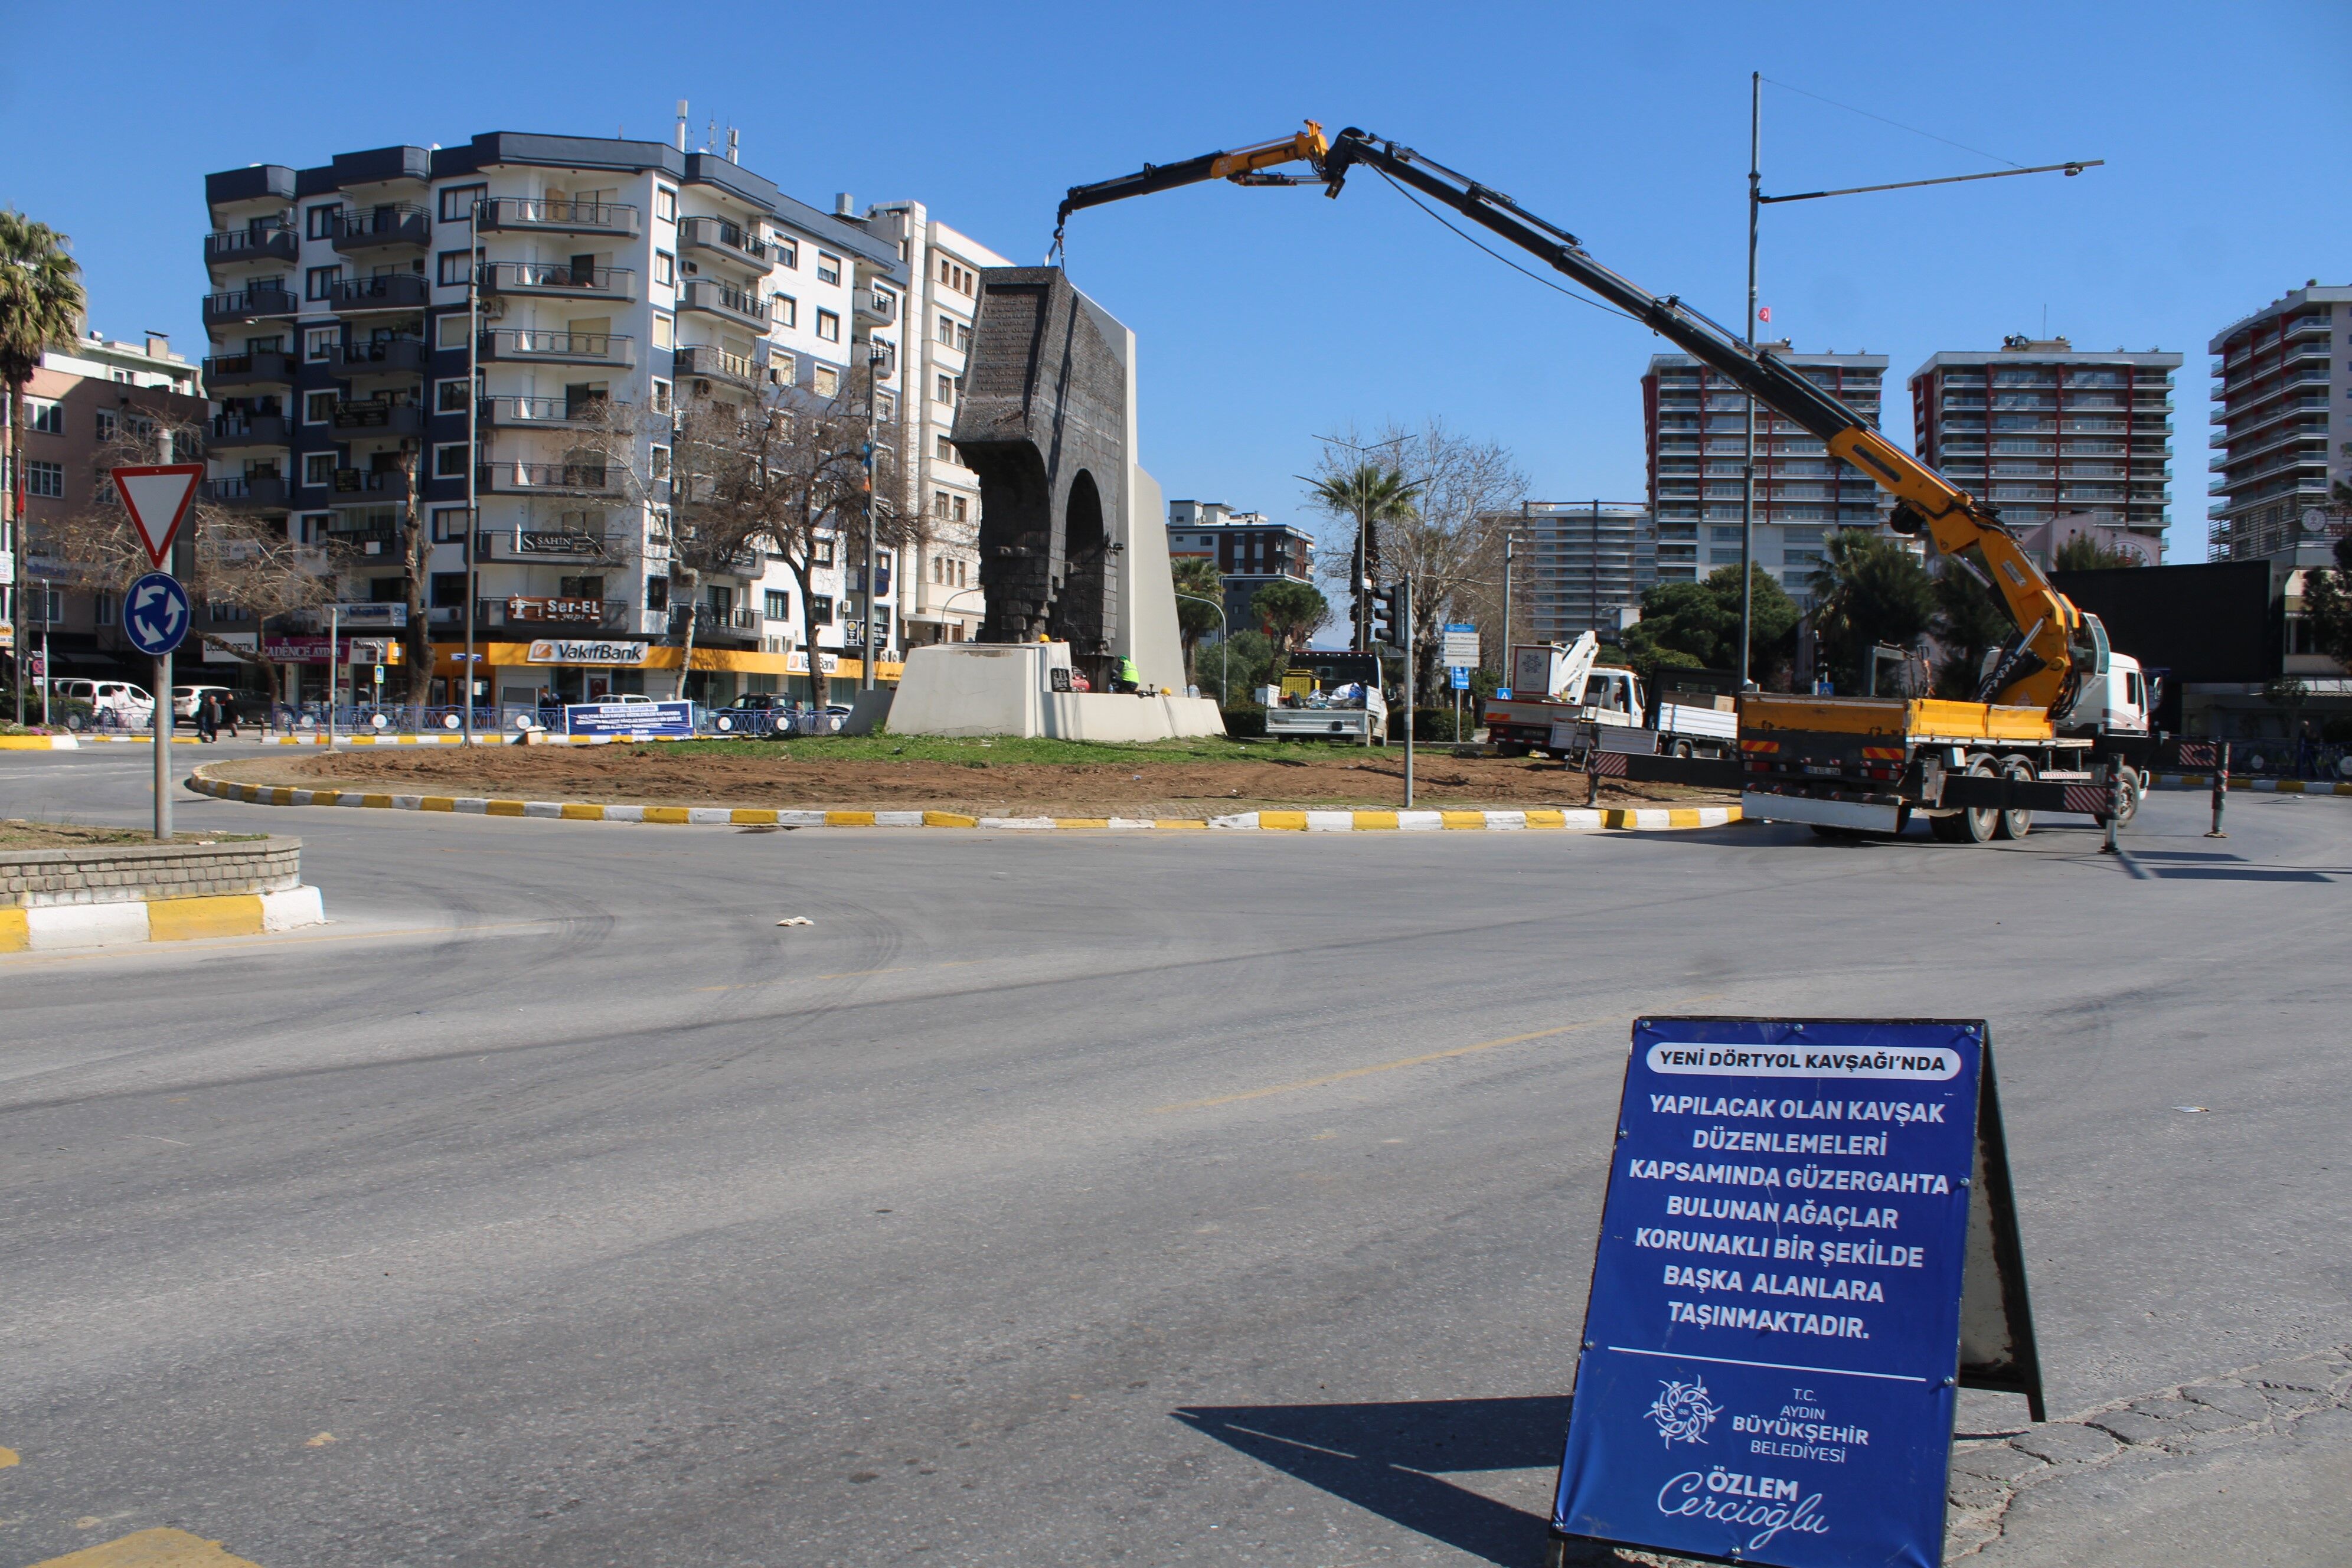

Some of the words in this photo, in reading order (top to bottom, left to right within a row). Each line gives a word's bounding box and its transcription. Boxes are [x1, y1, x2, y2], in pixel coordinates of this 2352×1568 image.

[547, 600, 600, 613] Ser-EL
[558, 643, 642, 660] VakıfBank
[1661, 1048, 1704, 1066] YENİ
[1710, 1050, 1801, 1068] DÖRTYOL
[1806, 1052, 1946, 1073] KAVŞAĞI'NDA
[1651, 1095, 1776, 1117] YAPILACAK
[1782, 1100, 1841, 1119] OLAN
[1849, 1102, 1945, 1126] KAVŞAK
[1694, 1126, 1887, 1155] DÜZENLEMELERİ
[1630, 1159, 1780, 1187] KAPSAMINDA
[1787, 1164, 1948, 1194] GÜZERGAHTA
[1667, 1196, 1779, 1222] BULUNAN
[1783, 1200, 1897, 1229] AĞAÇLAR
[1636, 1228, 1768, 1257] KORUNAKLI
[1775, 1236, 1814, 1260] BİR
[1821, 1239, 1923, 1267] ŞEKİLDE
[1664, 1266, 1742, 1293] BAŞKA
[1752, 1274, 1883, 1302] ALANLARA
[1669, 1302, 1870, 1338] TAŞINMAKTADIR.
[1792, 1388, 1817, 1402] T.C.
[1781, 1406, 1824, 1420] AYDIN
[1733, 1415, 1868, 1445] BÜYÜKŞEHİR
[1750, 1440, 1847, 1463] BELEDİYESİ
[1706, 1466, 1798, 1501] ÖZLEM
